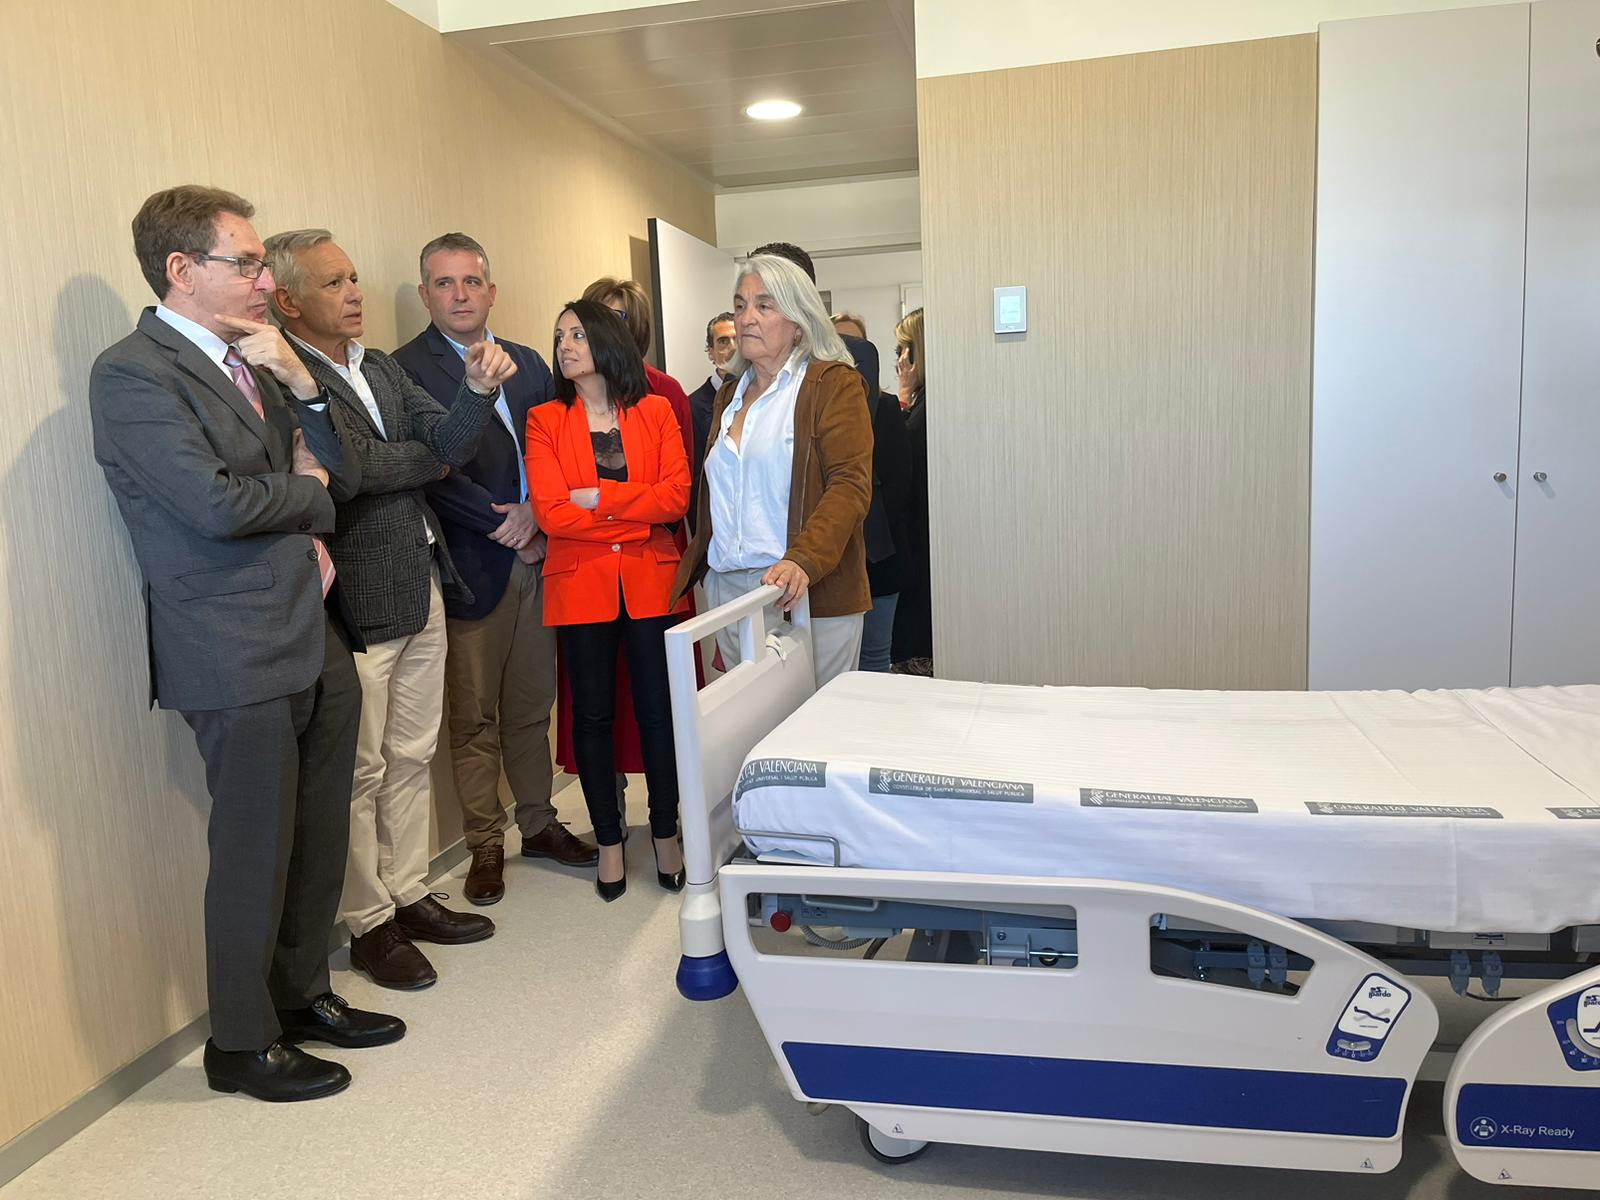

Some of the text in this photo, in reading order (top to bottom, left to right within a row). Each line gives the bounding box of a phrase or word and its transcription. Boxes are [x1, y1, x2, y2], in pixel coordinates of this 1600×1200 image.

[759, 759, 818, 774] VALENCIANA
[892, 771, 1025, 791] GENERALITAT VALENCIANA
[1105, 791, 1172, 801] GENERALITAT
[1176, 796, 1247, 806] VALENCIANA
[1501, 1124, 1575, 1139] X-Ray Ready
